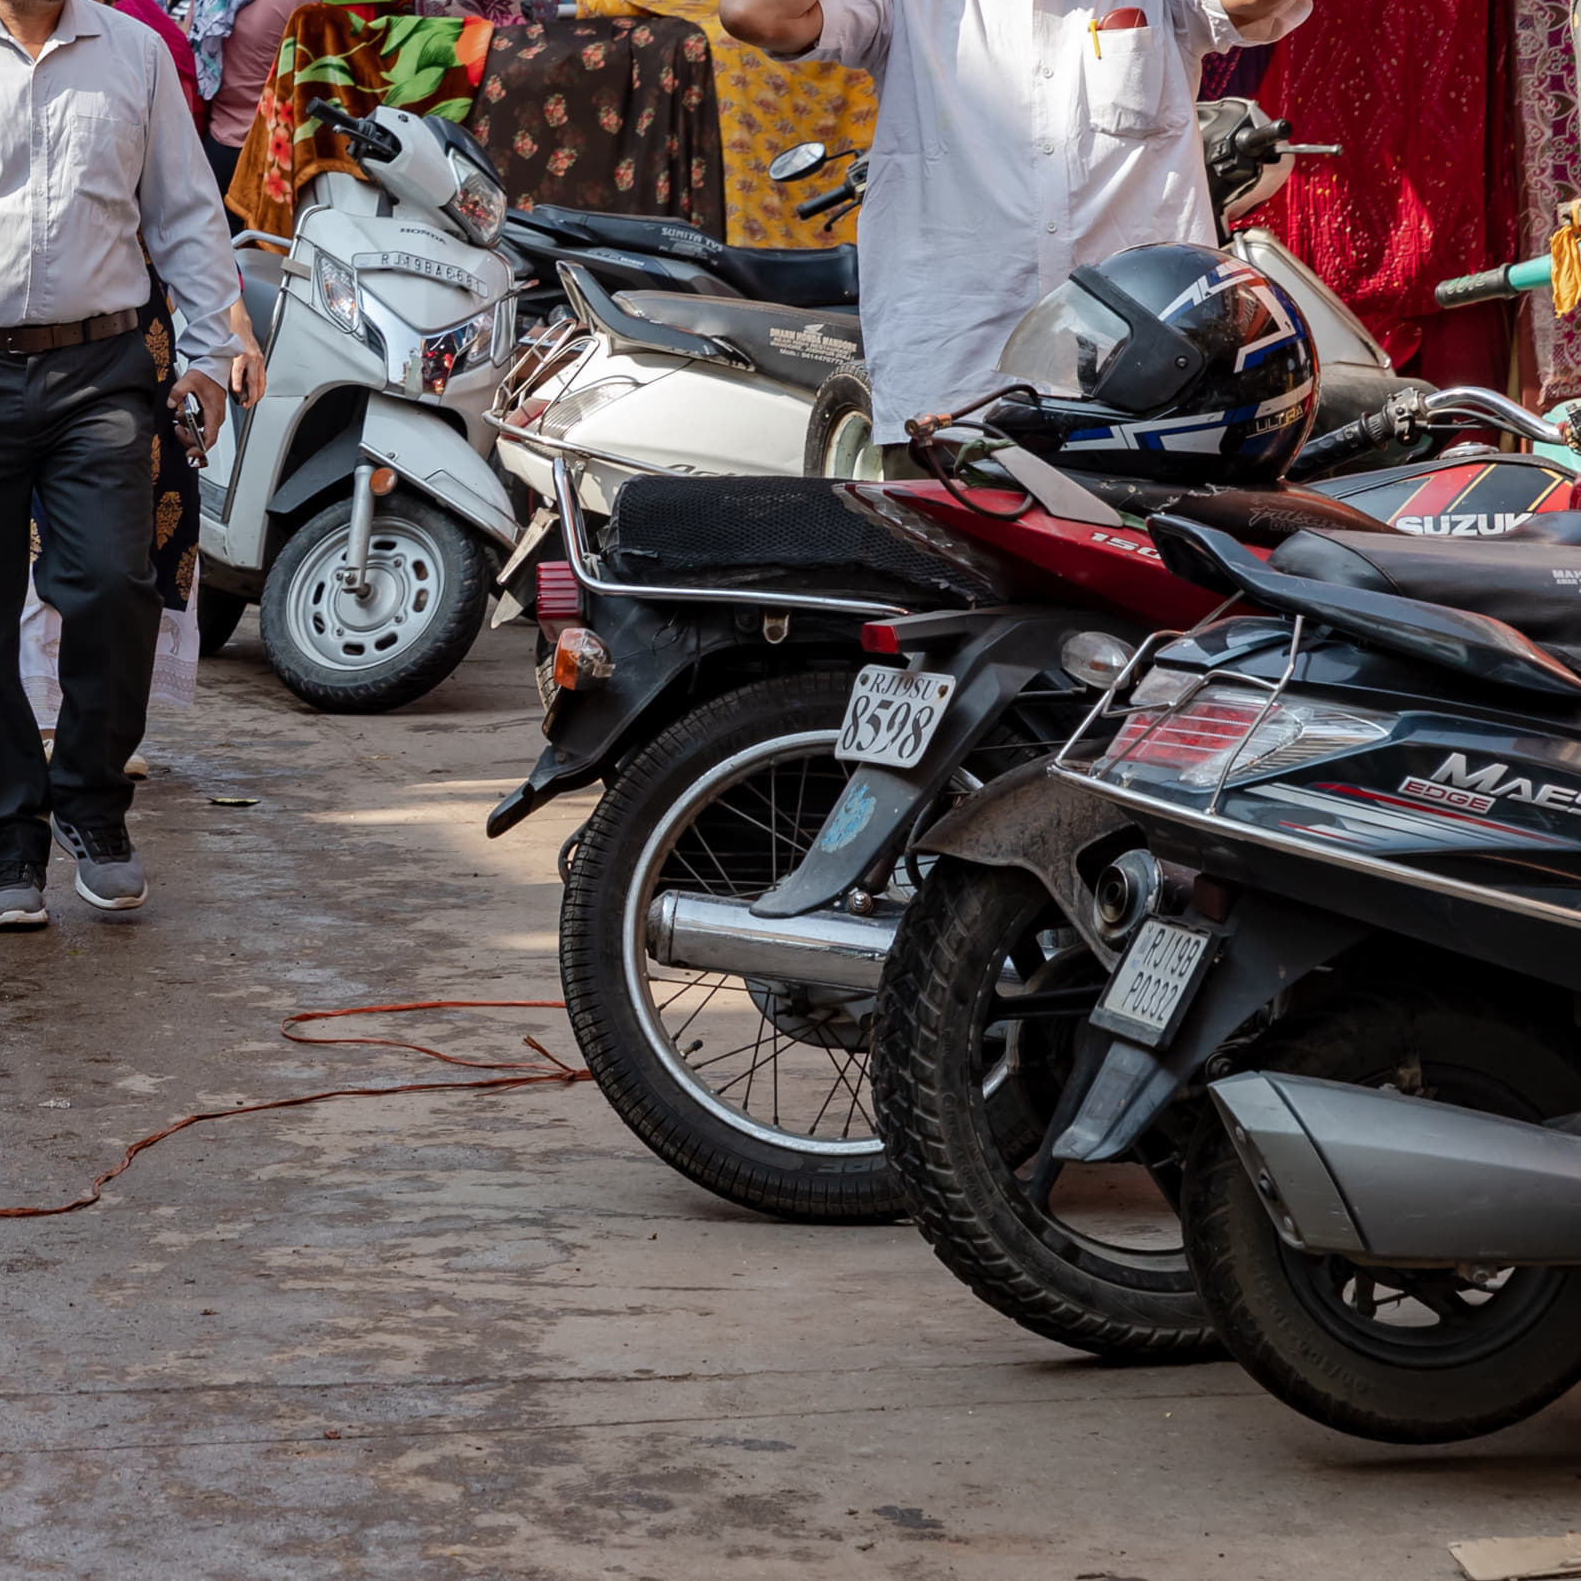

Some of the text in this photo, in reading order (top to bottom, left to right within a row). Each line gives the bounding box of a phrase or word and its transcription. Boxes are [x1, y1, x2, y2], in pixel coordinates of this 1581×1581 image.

[1255, 406, 1304, 433] ULTRA
[1393, 513, 1537, 536] SUZUK
[869, 672, 939, 697] RJ19SU
[842, 694, 935, 760] 8598
[1406, 780, 1490, 812] EDGE
[1147, 928, 1202, 977] RJ19B
[1128, 970, 1180, 1027] P0332
